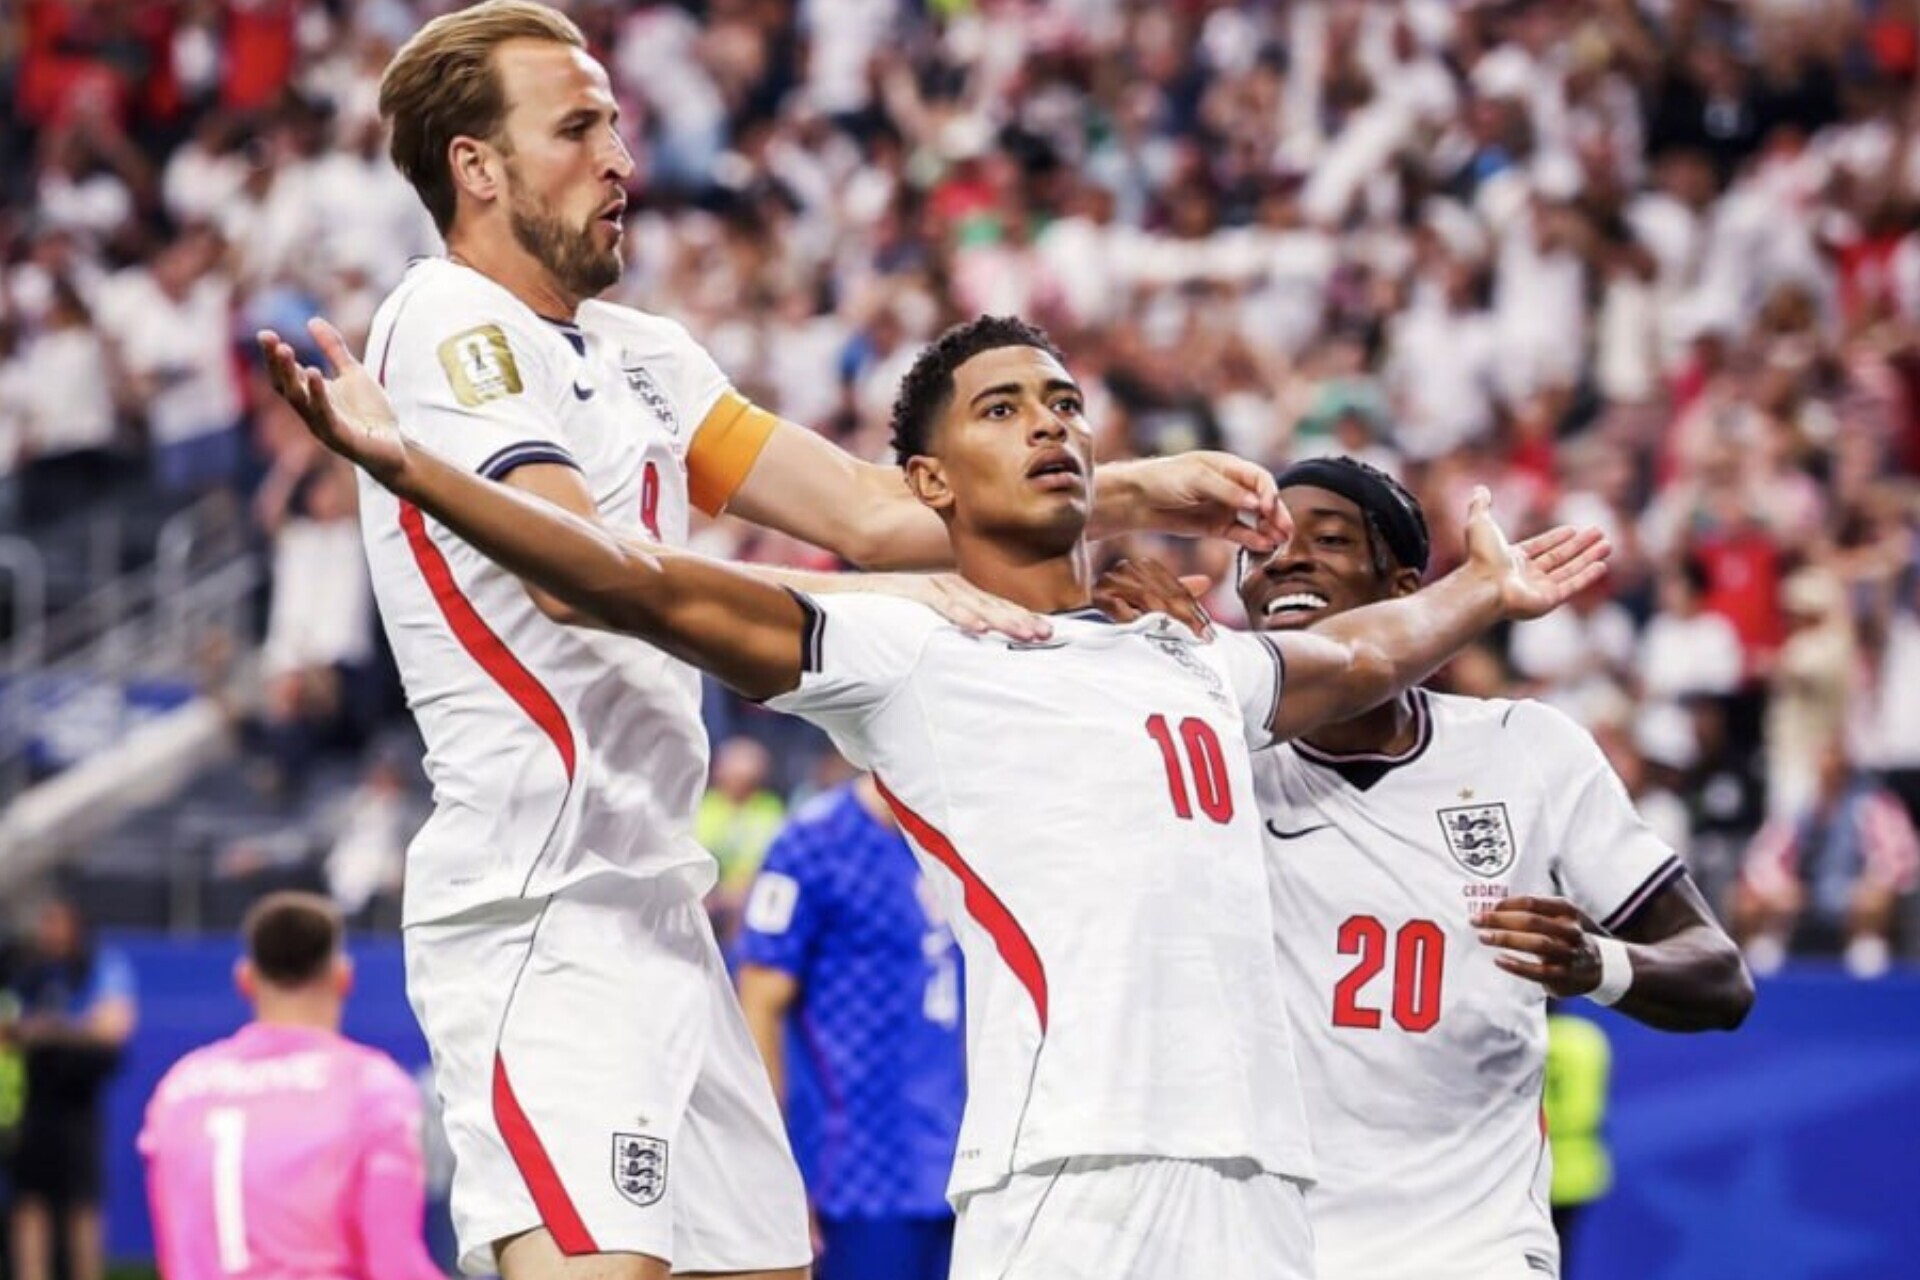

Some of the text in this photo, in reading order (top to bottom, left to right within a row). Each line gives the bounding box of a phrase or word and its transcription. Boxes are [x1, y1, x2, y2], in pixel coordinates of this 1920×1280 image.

[1145, 713, 1234, 824] 10
[1332, 914, 1445, 1033] 20
[206, 1108, 250, 1274] 1
